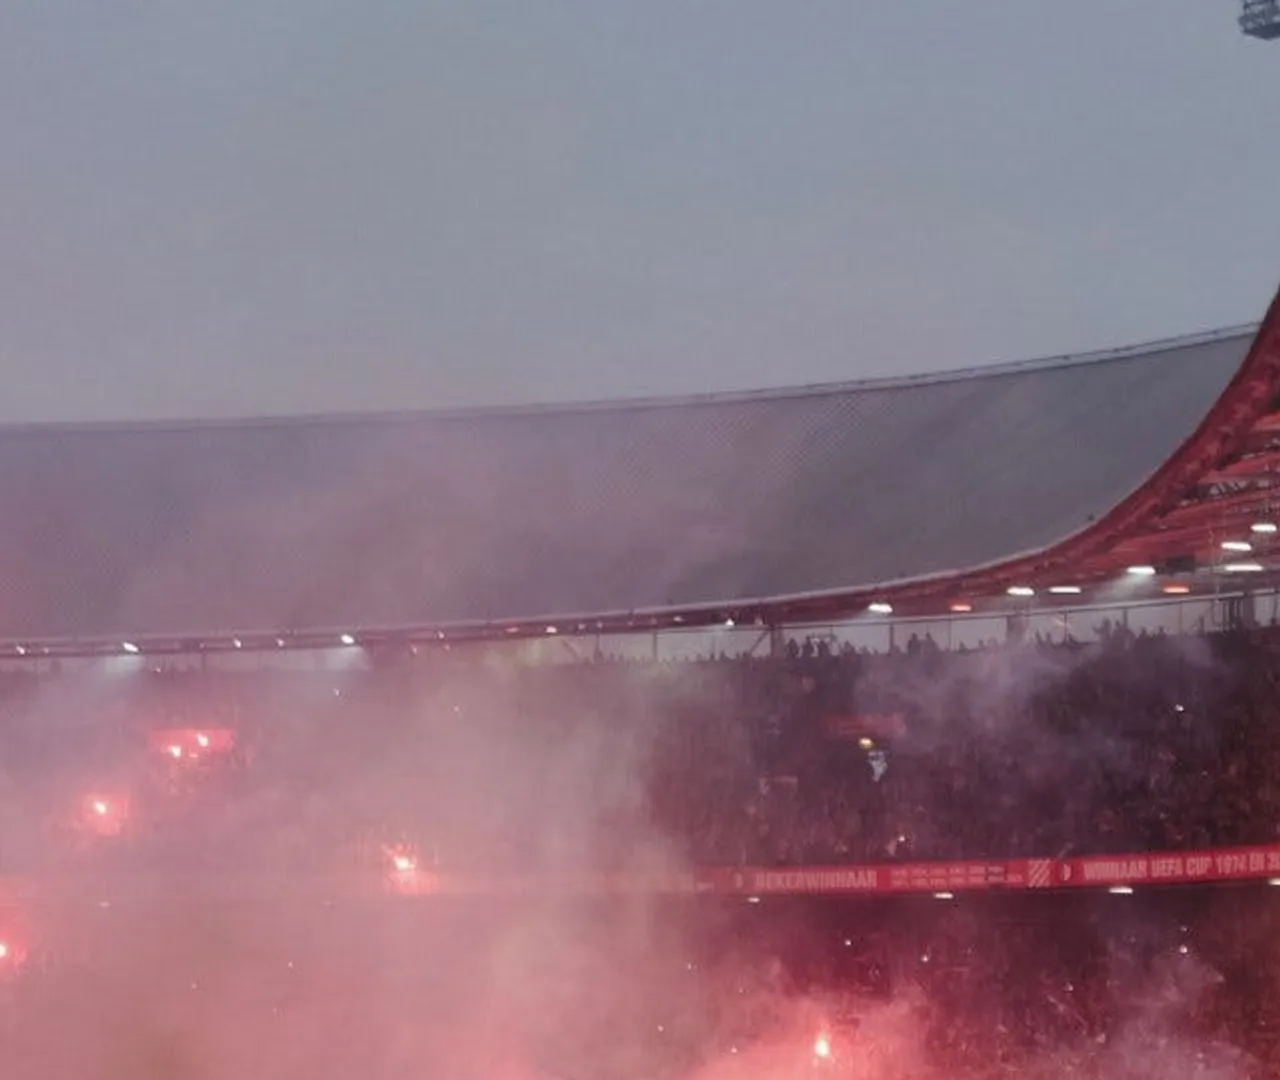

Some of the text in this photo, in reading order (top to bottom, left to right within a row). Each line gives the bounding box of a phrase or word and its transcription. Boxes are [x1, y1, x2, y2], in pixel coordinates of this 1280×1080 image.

[1084, 861, 1148, 880] WINNAAR
[1151, 857, 1183, 877] UEFA
[1186, 856, 1213, 875] CUP
[1217, 854, 1247, 874] 1974
